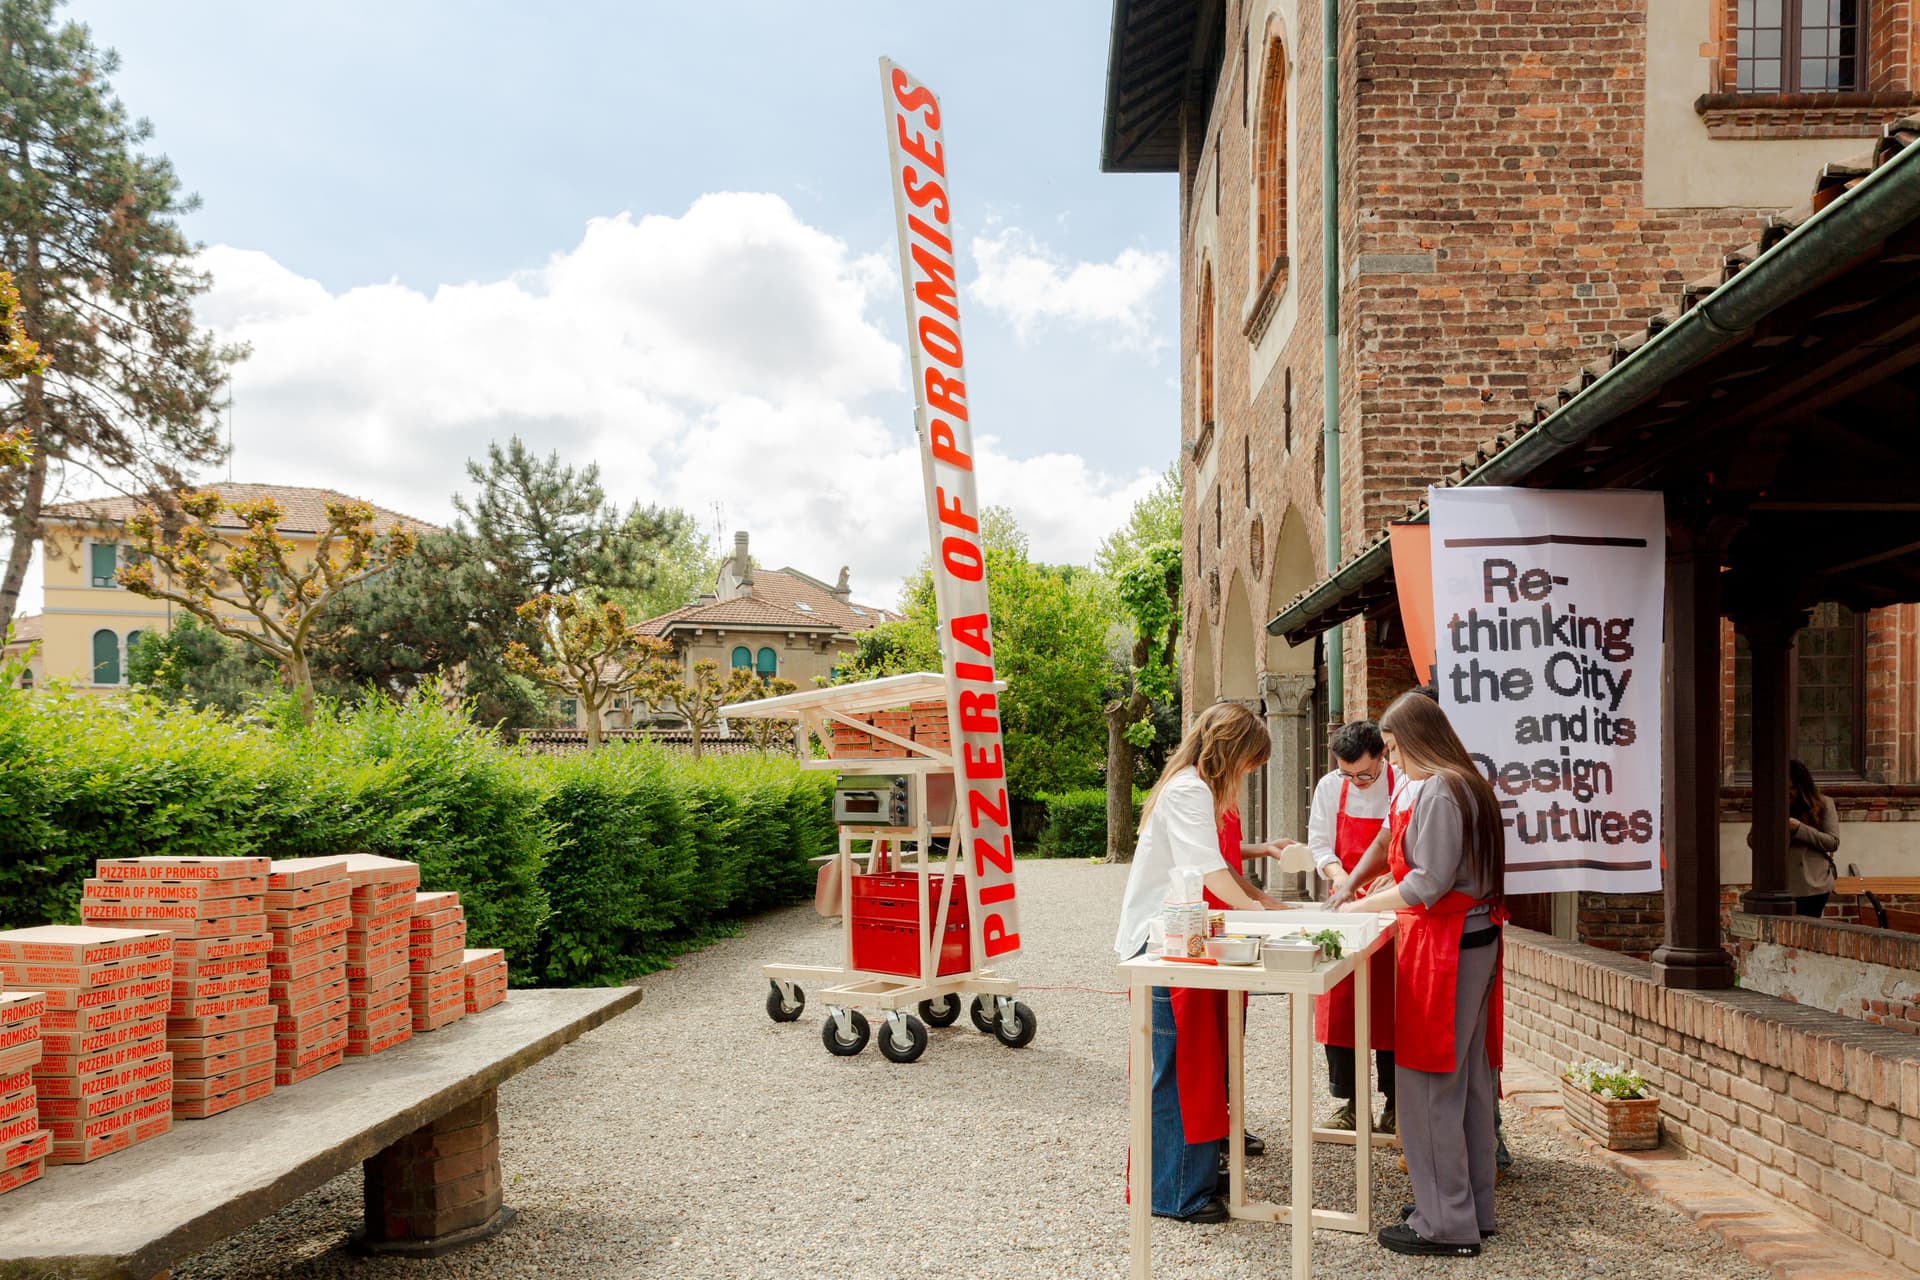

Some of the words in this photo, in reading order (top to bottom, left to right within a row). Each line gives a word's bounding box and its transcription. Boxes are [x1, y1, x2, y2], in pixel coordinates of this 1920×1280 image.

[891, 68, 973, 472] PROMISES
[935, 486, 984, 582] OF
[1482, 558, 1569, 602] Re-
[1447, 602, 1634, 662] thinking
[1449, 657, 1533, 704] the
[1544, 650, 1632, 711] City
[1515, 705, 1586, 745] and
[1593, 707, 1636, 746] its
[951, 613, 1020, 957] PIZZERIA
[100, 867, 147, 880] PIZZERIA
[150, 867, 162, 878] OF
[165, 866, 219, 879] PROMISES
[86, 886, 130, 899] PIZZERIA
[133, 886, 145, 898] OF
[147, 886, 198, 899] PROMISES
[83, 905, 128, 919] PIZZERIA
[131, 906, 143, 918] OF
[145, 906, 197, 919] PROMISES
[85, 946, 121, 964] PIZZERIA
[122, 944, 132, 957] OF
[133, 937, 171, 956] PROMISES
[198, 963, 225, 977] PIZZERIA
[227, 961, 235, 973] OF
[236, 957, 265, 971] PROMISES
[90, 966, 125, 985] PIZZERIA
[126, 964, 135, 977] OF
[137, 958, 172, 976] PROMISES
[197, 982, 226, 996] PIZZERIA
[229, 980, 236, 992] OF
[238, 975, 269, 990] PROMISES
[77, 989, 116, 1008] PIZZERIA
[118, 987, 128, 1000] OF
[130, 979, 170, 998] PROMISES
[195, 1000, 224, 1016] PIZZERIA
[227, 999, 234, 1012] OF
[236, 994, 267, 1009] PROMISES
[1, 1000, 44, 1024] PROMISES
[88, 1009, 121, 1029] PIZZERIA
[123, 1007, 132, 1020] OF
[134, 999, 169, 1018] PROMISES
[82, 1032, 116, 1052] PIZZERIA
[118, 1029, 127, 1042] OF
[129, 1019, 165, 1040] PROMISES
[78, 1054, 114, 1075] PIZZERIA
[115, 1051, 125, 1064] OF
[127, 1039, 164, 1060] PROMISES
[82, 1075, 119, 1096] PIZZERIA
[121, 1071, 131, 1084] OF
[133, 1059, 171, 1080] PROMISES
[89, 1095, 122, 1116] PIZZERIA
[124, 1091, 134, 1105] OF
[136, 1079, 171, 1101] PROMISES
[86, 1117, 121, 1138] PIZZERIA
[123, 1113, 132, 1127] OF
[134, 1099, 170, 1122] PROMISES
